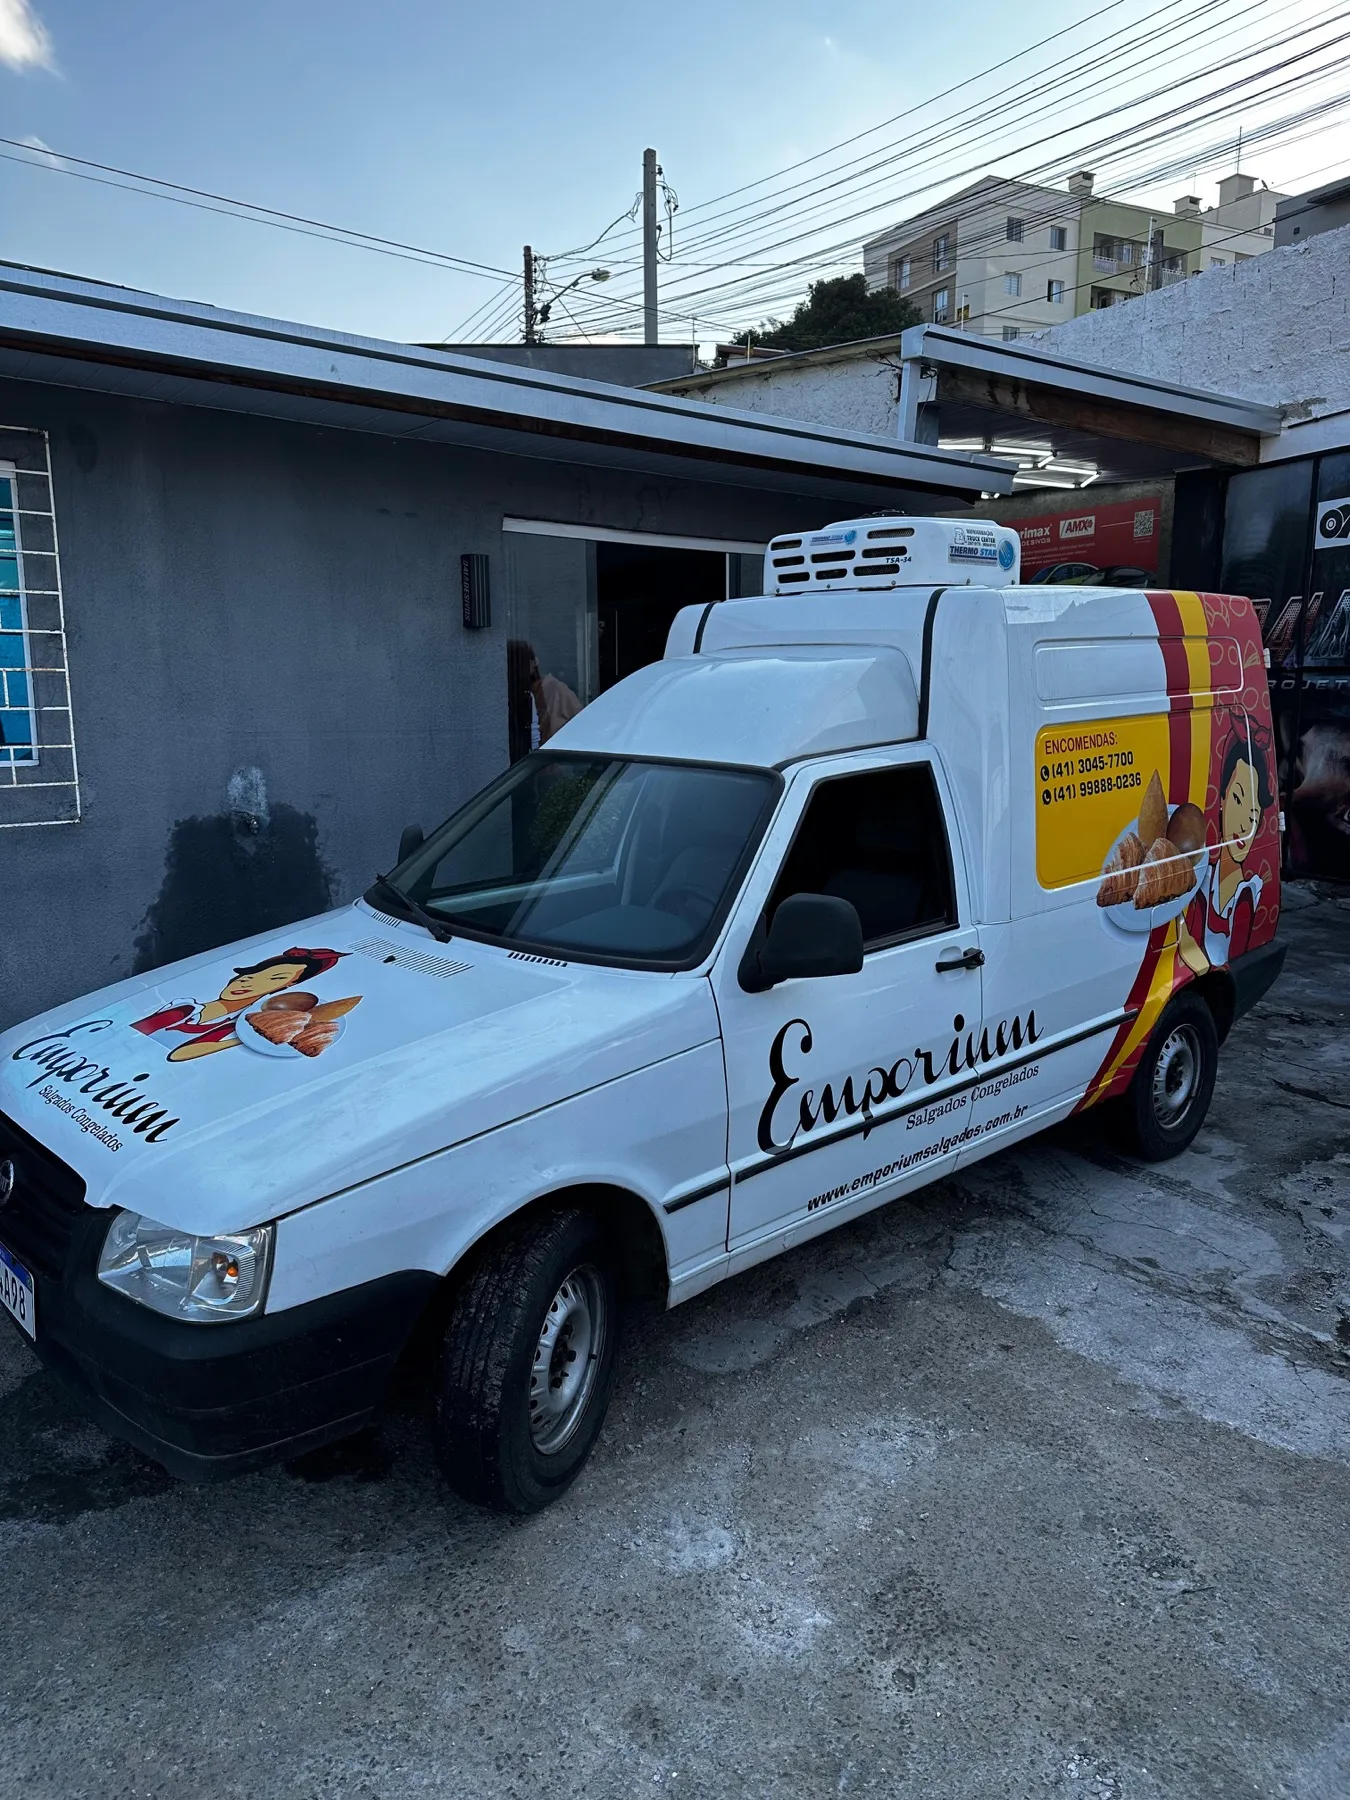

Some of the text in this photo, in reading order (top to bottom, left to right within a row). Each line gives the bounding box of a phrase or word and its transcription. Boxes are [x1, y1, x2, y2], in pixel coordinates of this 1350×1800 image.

[885, 556, 912, 564] TSA-34
[949, 545, 998, 557] THERMO STAR
[1045, 731, 1118, 755] ENCOMENDAS:
[1052, 751, 1134, 779] (41) 3045-7700
[1053, 772, 1141, 802] (41) 99888-0236
[12, 1019, 181, 1143] Emporium
[757, 1009, 1044, 1156] Emporium
[905, 1064, 1039, 1131] Salgados Congelados
[38, 1084, 123, 1152] Salgados Congelados
[807, 1104, 1028, 1212] www.emporiumsalgados.com.br
